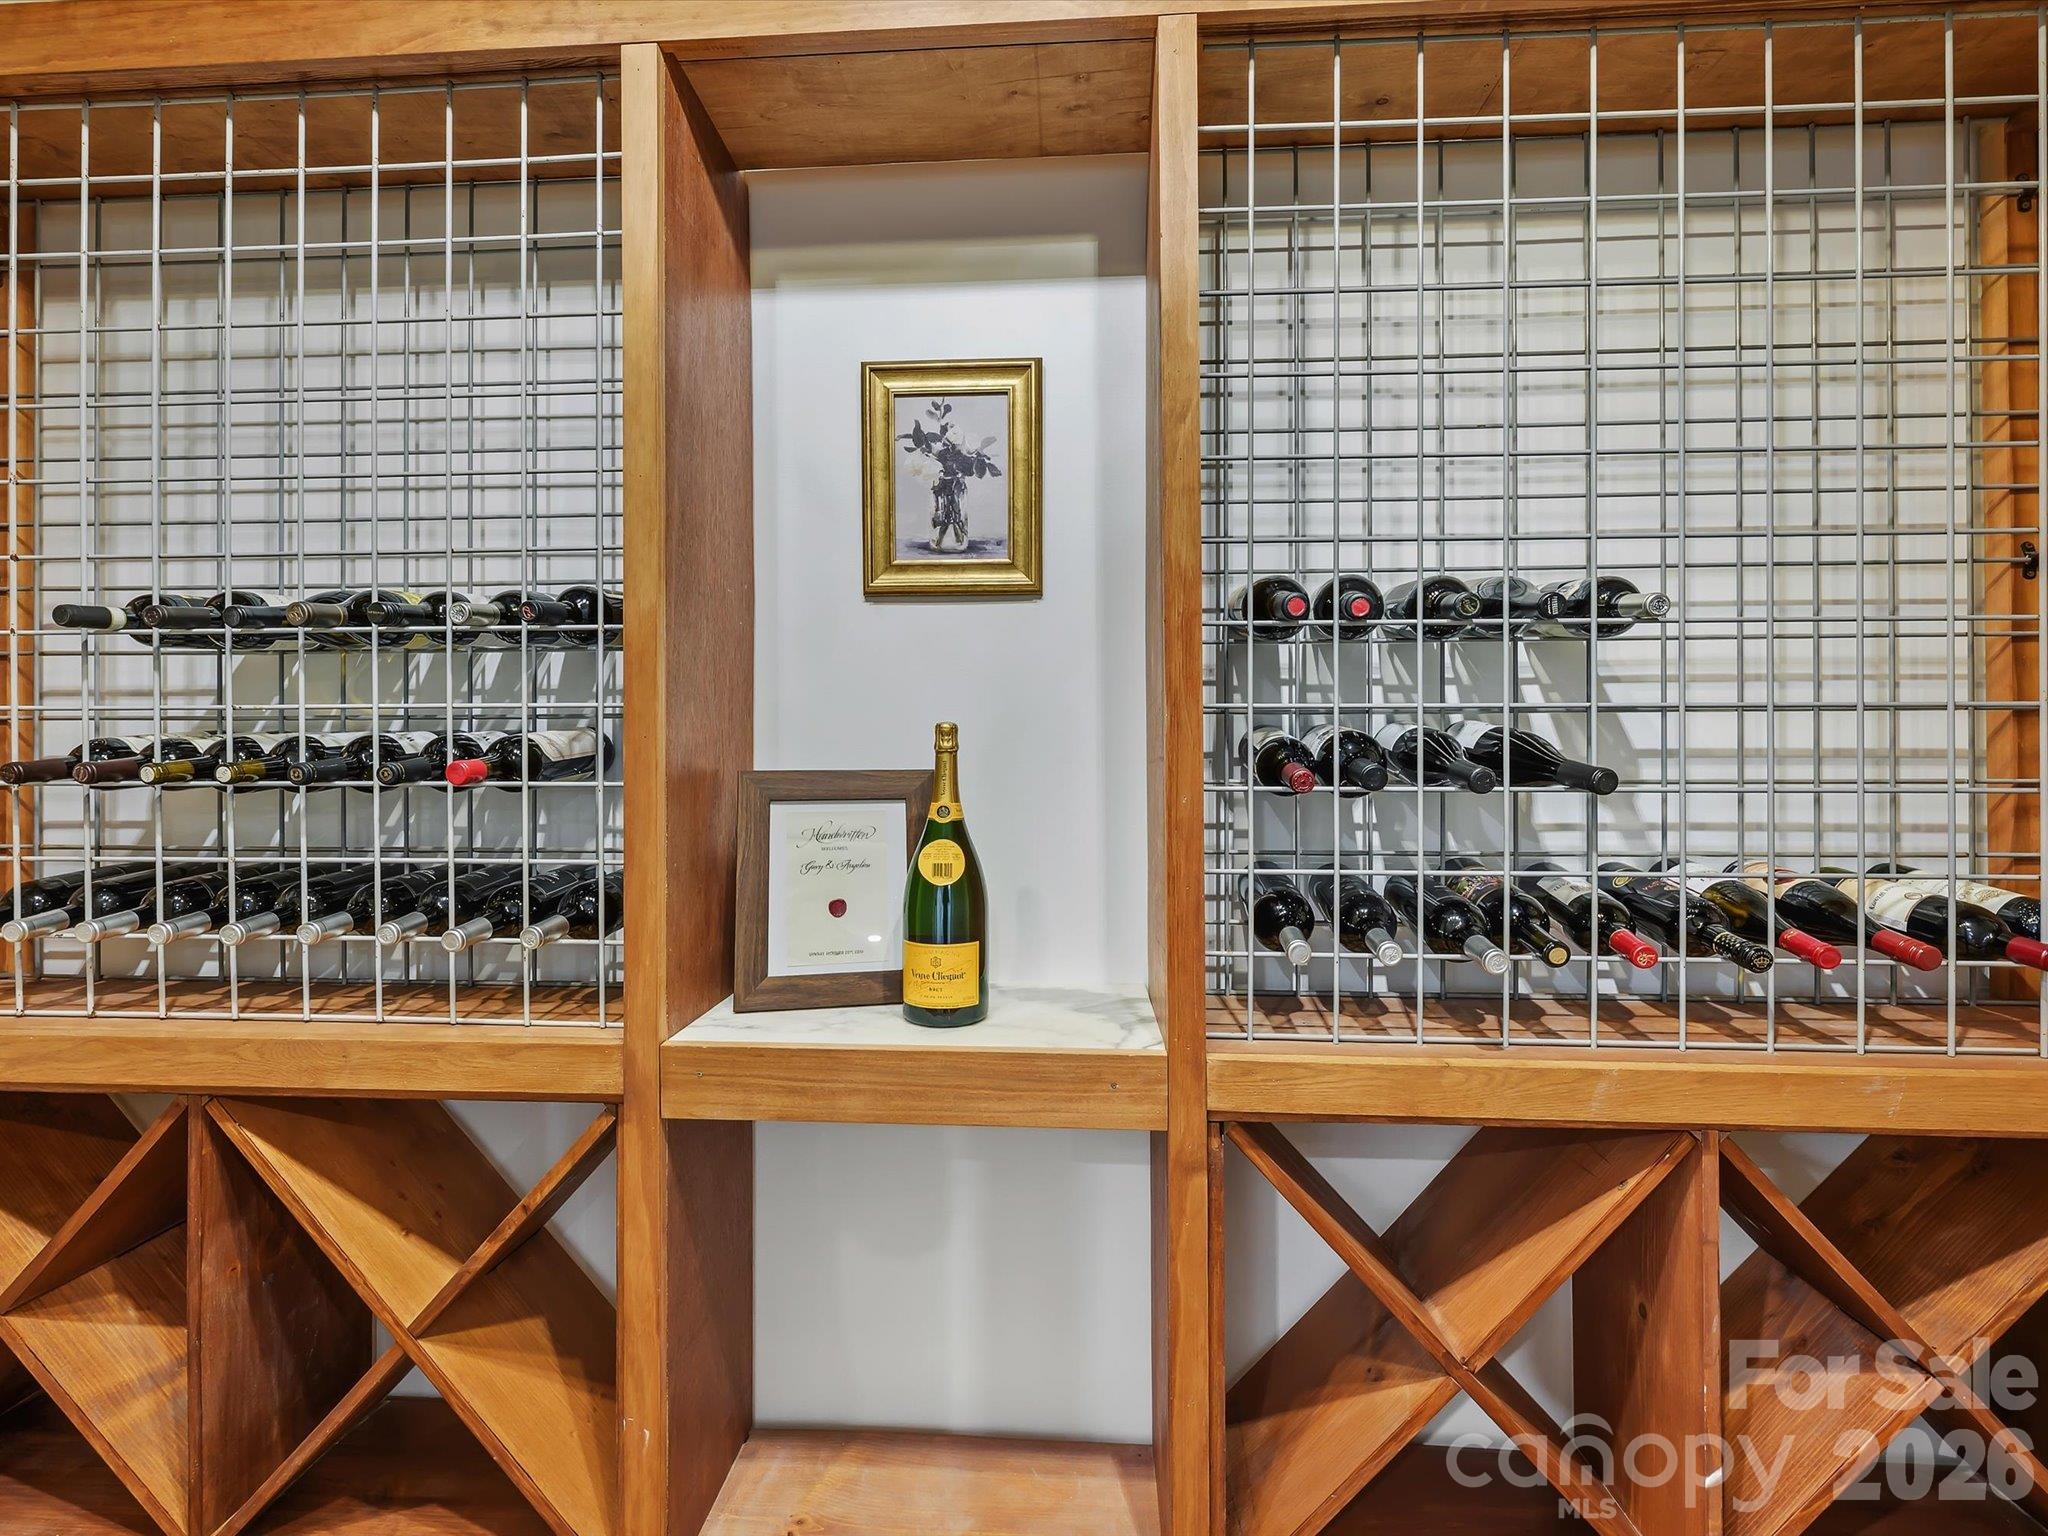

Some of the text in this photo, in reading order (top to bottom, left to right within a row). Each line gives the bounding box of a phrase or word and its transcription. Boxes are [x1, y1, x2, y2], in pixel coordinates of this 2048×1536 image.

[796, 820, 877, 849] Handwritten
[825, 859, 834, 869] &
[911, 969, 966, 981] Veuve Clicquot
